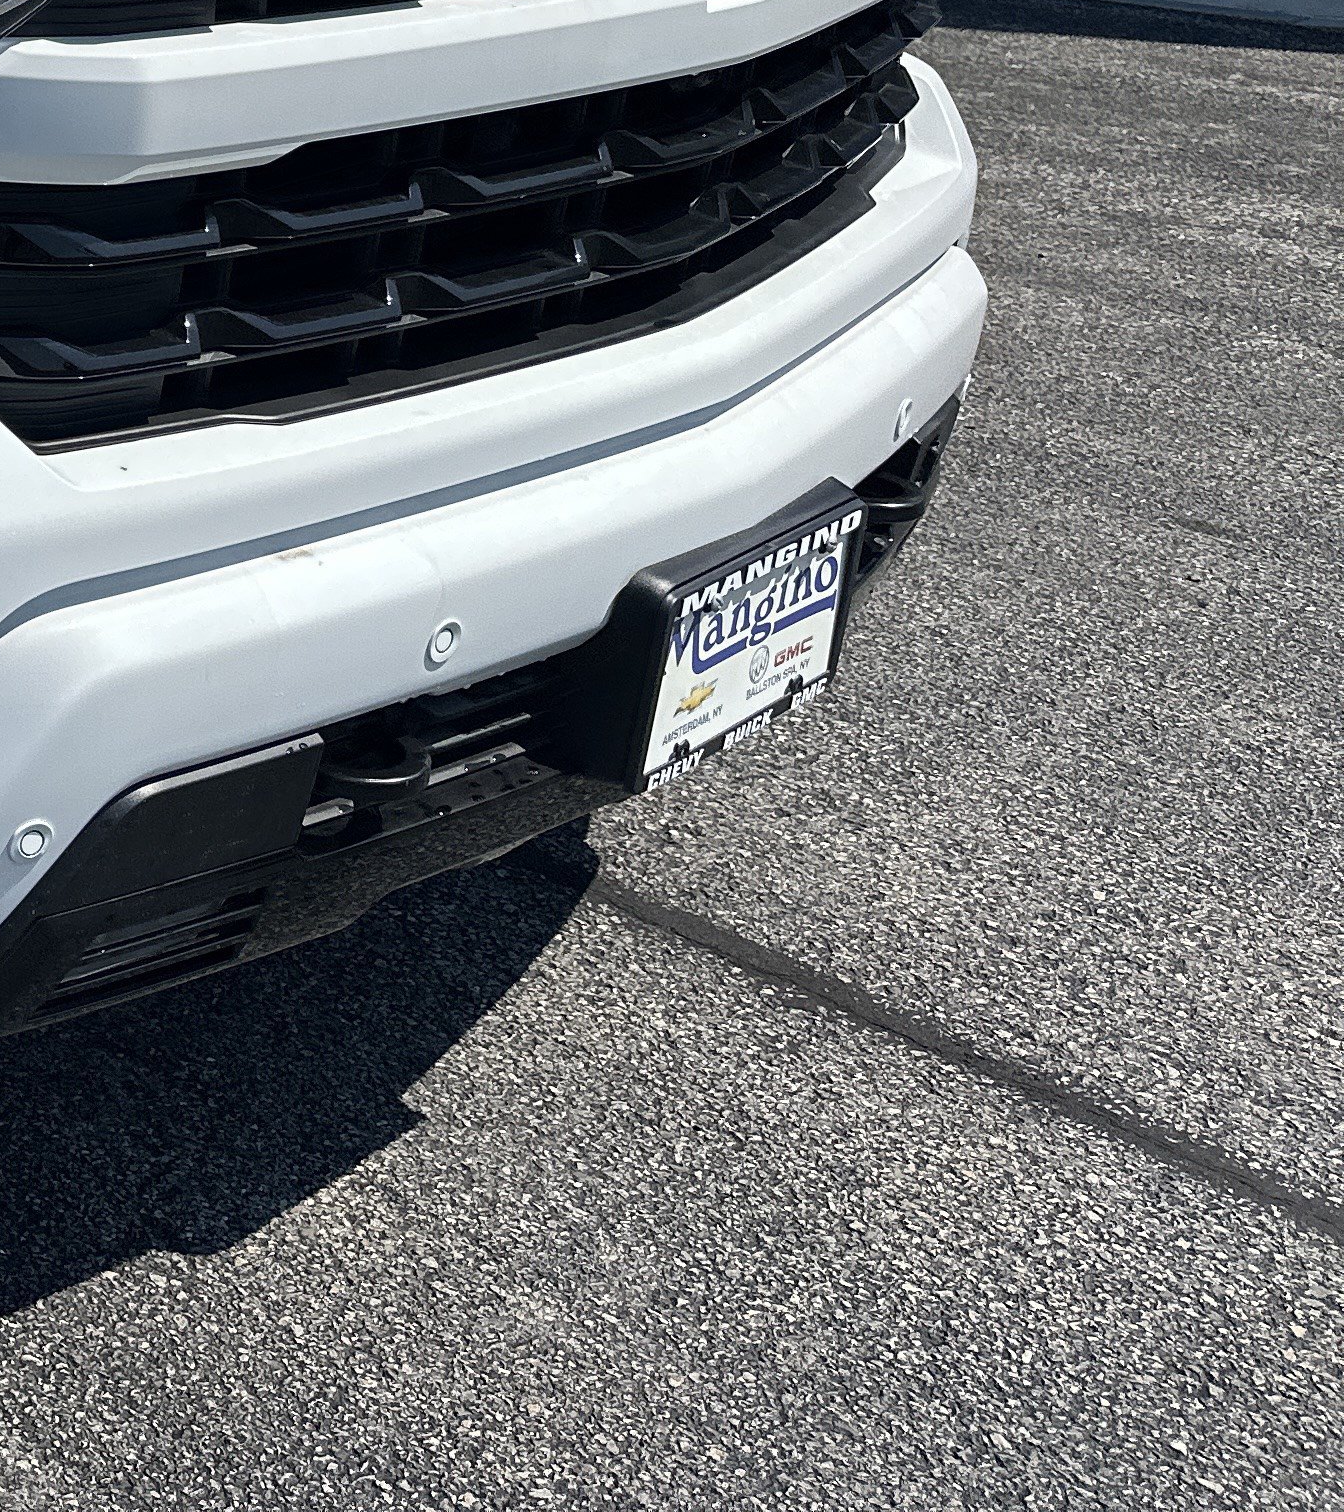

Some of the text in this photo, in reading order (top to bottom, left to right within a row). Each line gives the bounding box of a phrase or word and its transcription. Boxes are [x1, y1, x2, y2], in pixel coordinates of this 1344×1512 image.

[669, 556, 839, 675] Mangino
[680, 509, 863, 618] MANGINO
[773, 636, 814, 668] GMC
[647, 678, 828, 792] CHEVY BUICK GMC
